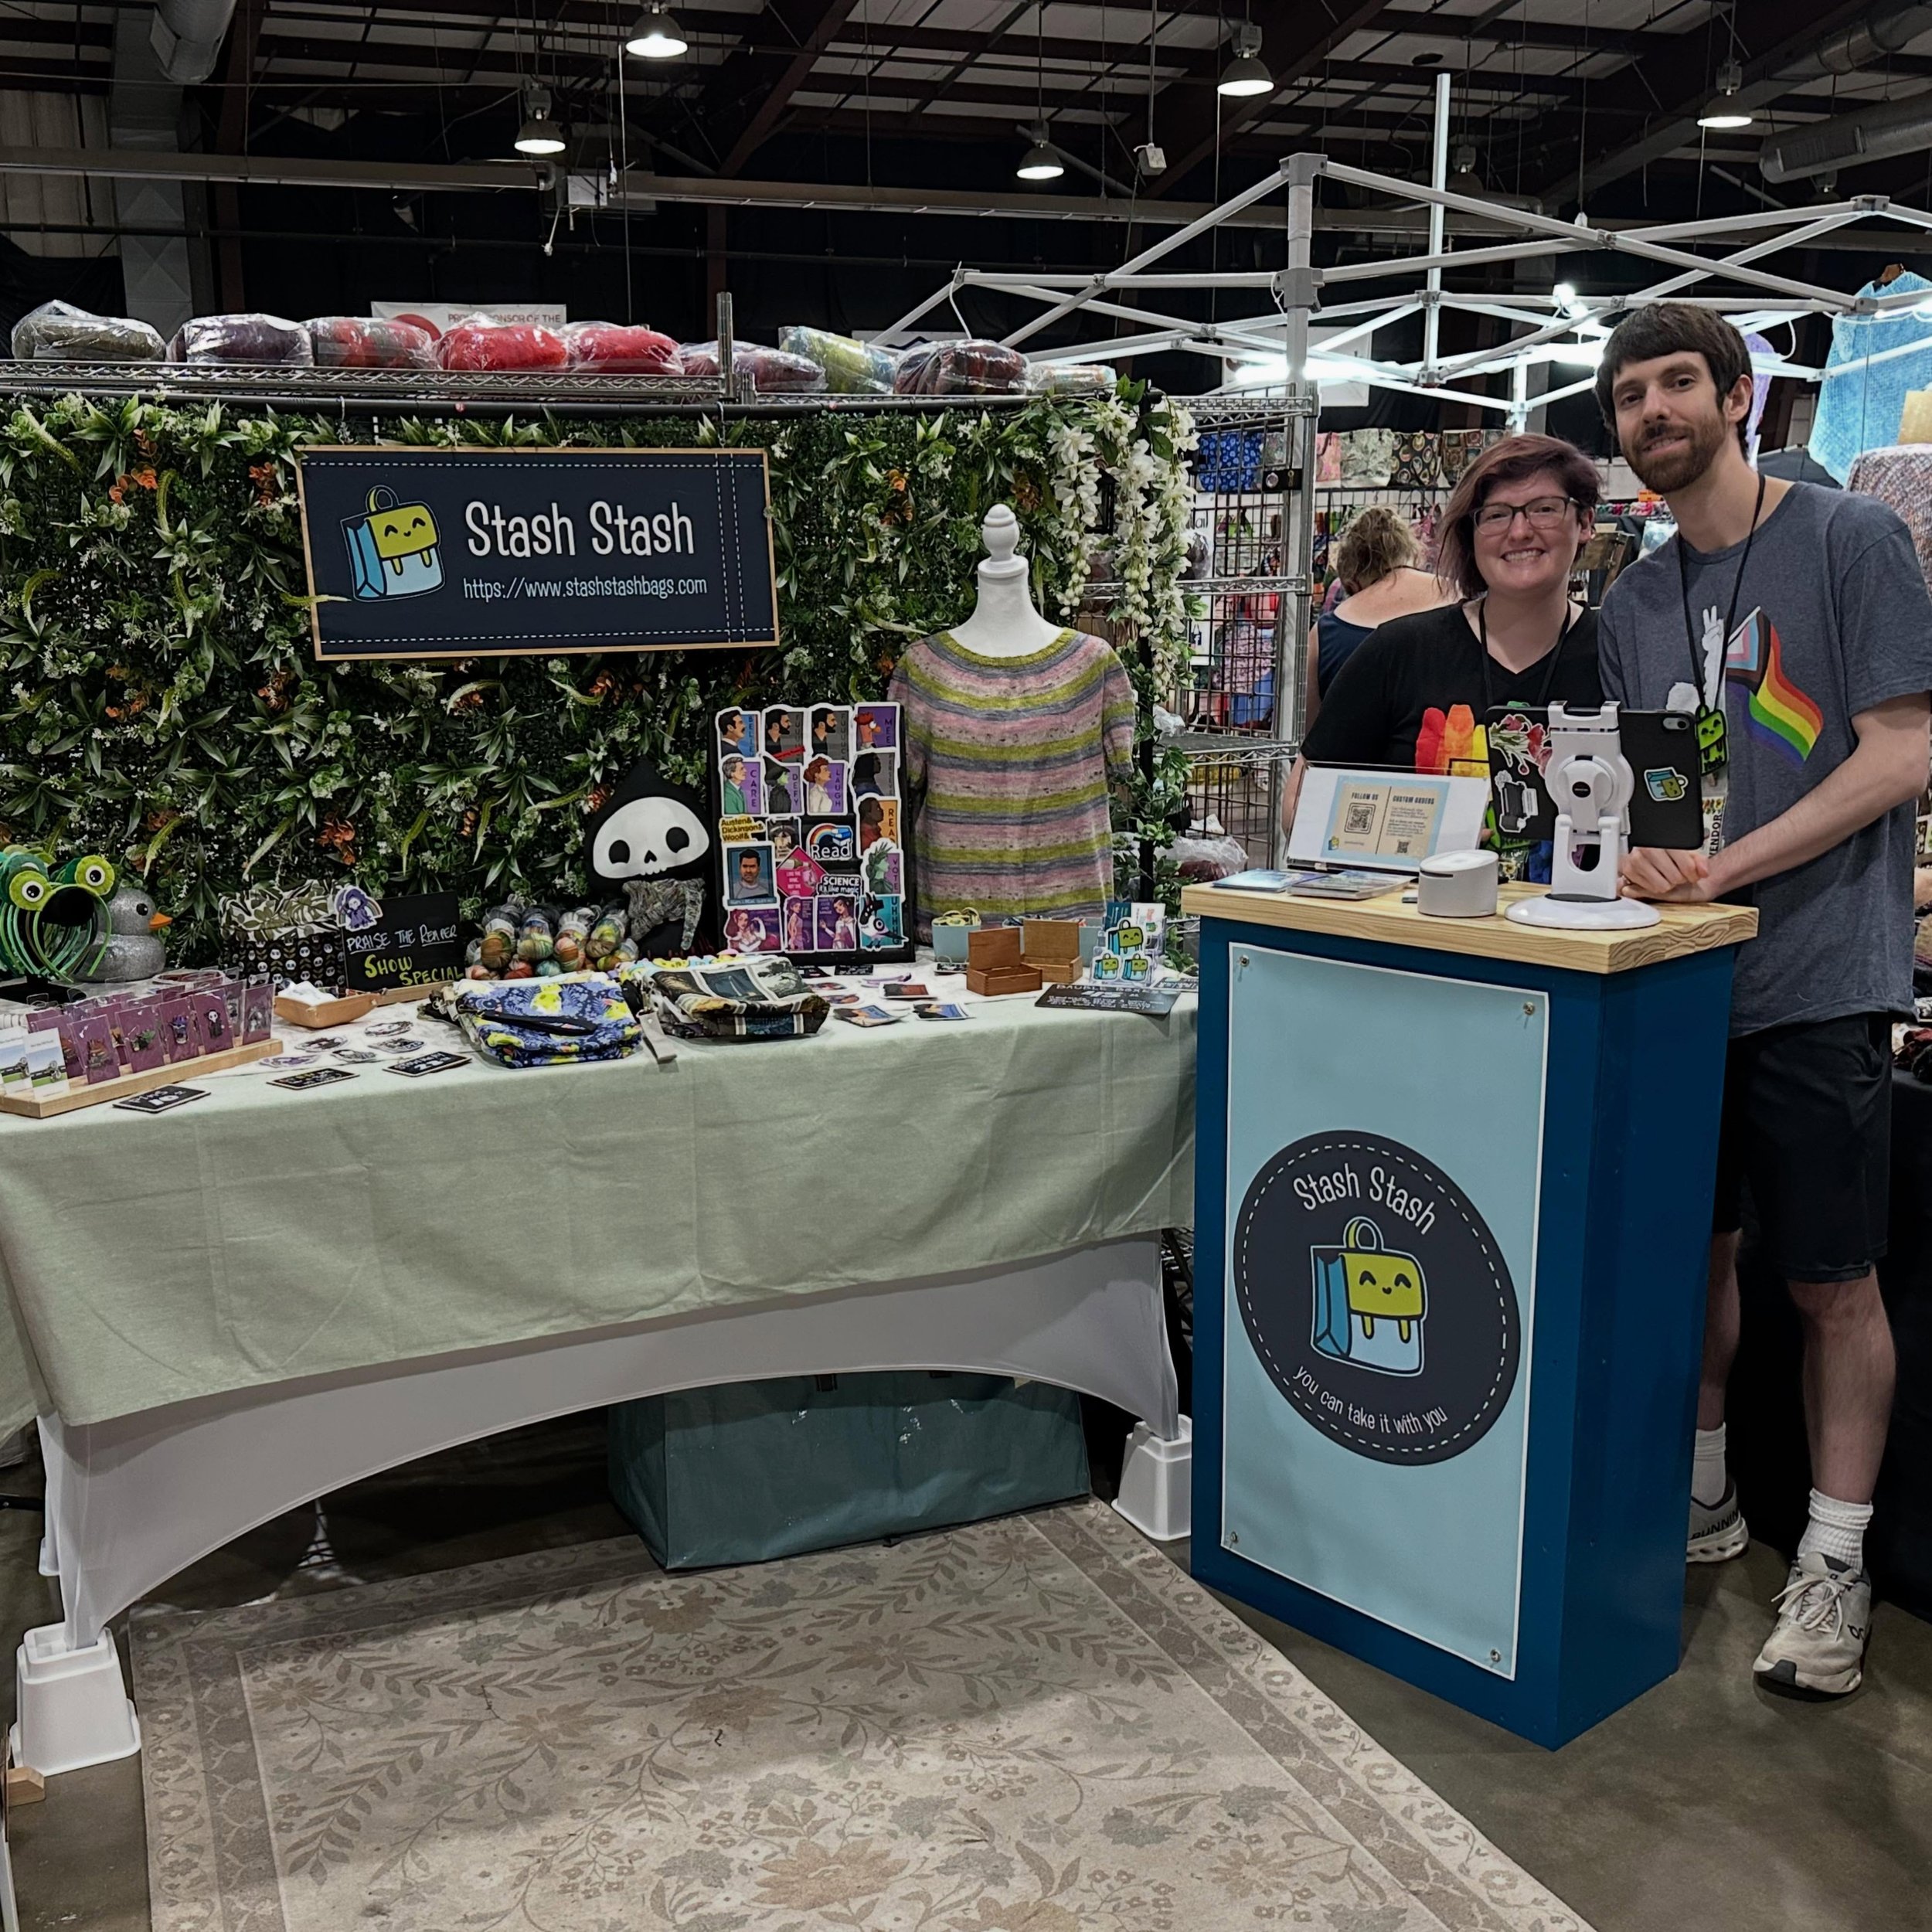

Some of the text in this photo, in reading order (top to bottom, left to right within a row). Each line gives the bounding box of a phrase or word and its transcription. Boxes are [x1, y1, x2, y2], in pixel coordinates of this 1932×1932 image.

[526, 314, 539, 323] OF
[542, 314, 562, 323] THE
[465, 501, 695, 557] Stash Stash
[463, 576, 708, 603] https://www.stashstashbags.com
[884, 719, 893, 745] MEE
[721, 817, 752, 826] Austen&
[722, 823, 764, 834] Dickinson&
[811, 842, 850, 859] Read
[823, 876, 860, 886] SCIENCE
[346, 932, 391, 951] PRAISE
[394, 929, 416, 944] THE
[364, 954, 413, 978] SHOW
[399, 966, 464, 986] SPECIAL
[1293, 1162, 1436, 1236] Stash Stash
[1292, 1366, 1448, 1435] you can take it with you
